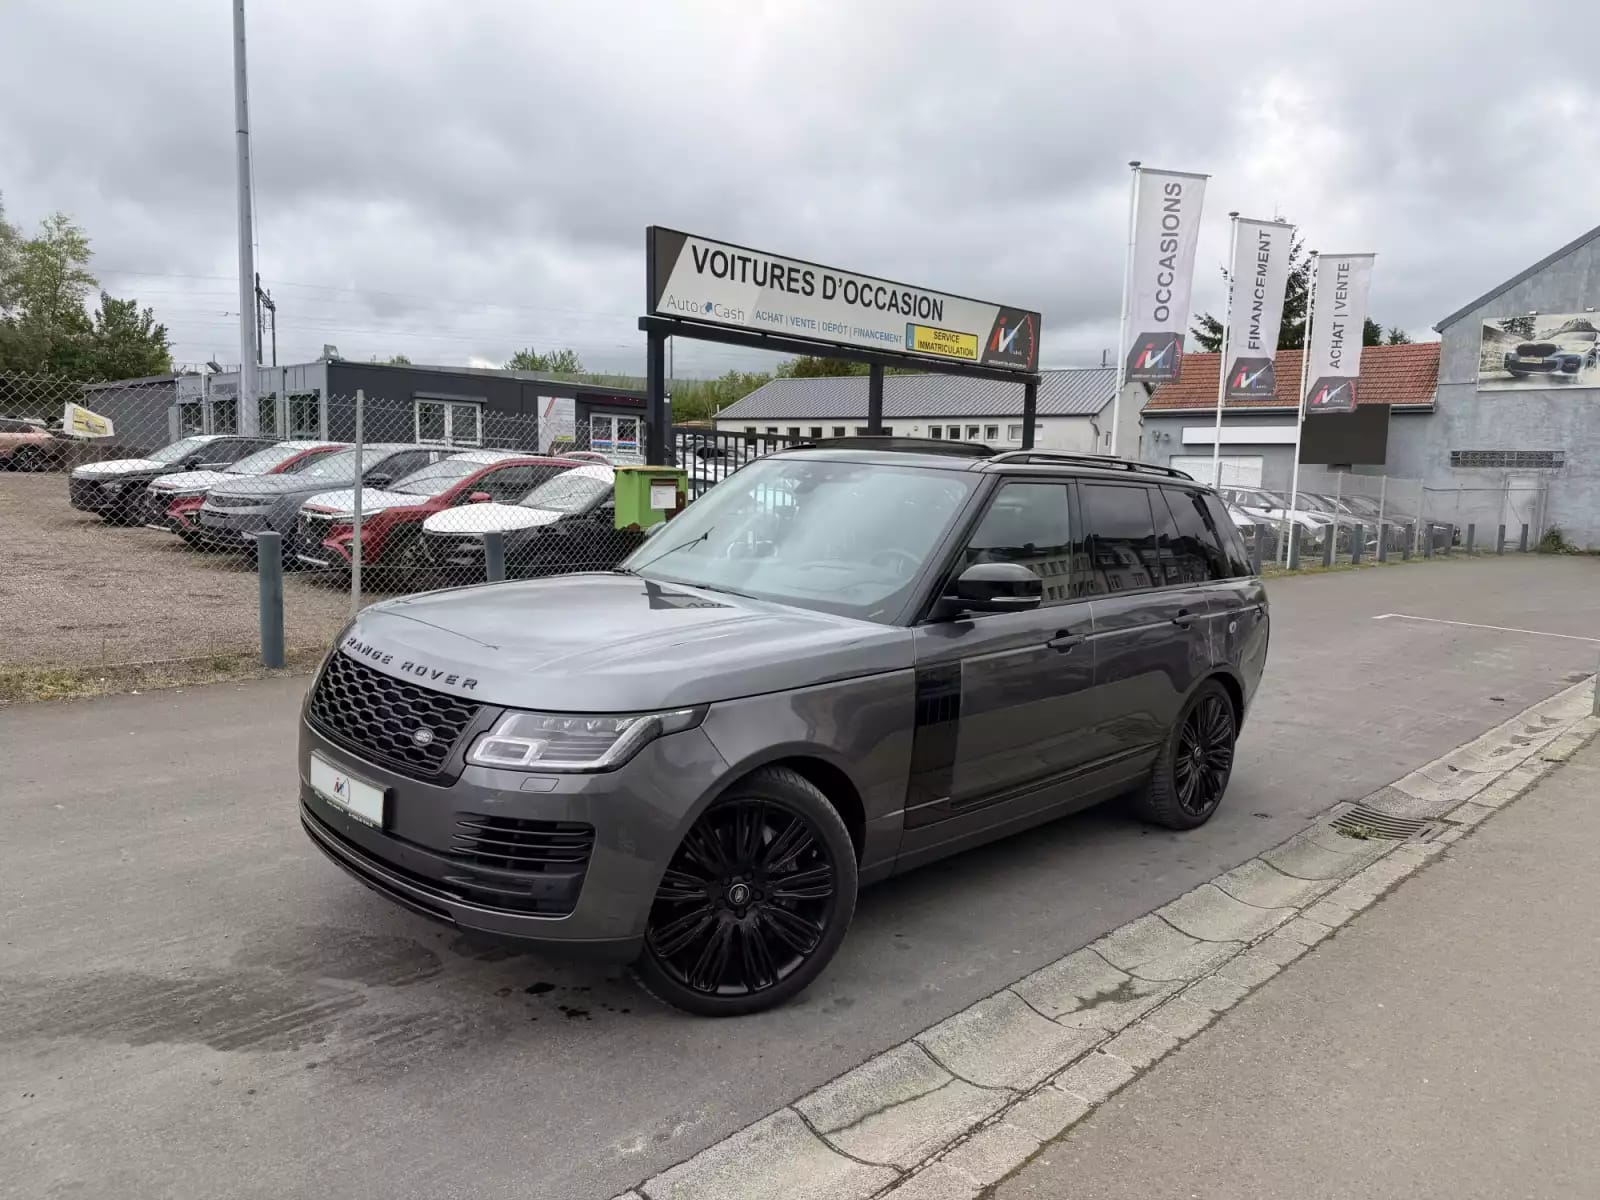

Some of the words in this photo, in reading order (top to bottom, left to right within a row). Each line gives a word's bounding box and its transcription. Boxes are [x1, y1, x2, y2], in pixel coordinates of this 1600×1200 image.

[1153, 182, 1182, 323] OCCASIONS
[692, 245, 815, 296] VOITURES
[822, 275, 943, 322] D'OCCASION
[1248, 229, 1271, 350] FINANCEMENT
[1334, 262, 1350, 310] VENTE
[755, 309, 784, 324] ACHAT
[790, 315, 817, 330] VENTE
[853, 327, 903, 345] FINANCEMENT
[917, 339, 974, 357] IMMATRICULATION
[933, 331, 960, 343] SERVICE
[1329, 321, 1345, 369] ACHAT
[346, 637, 393, 665] RANGE
[401, 661, 478, 690] ROVER
